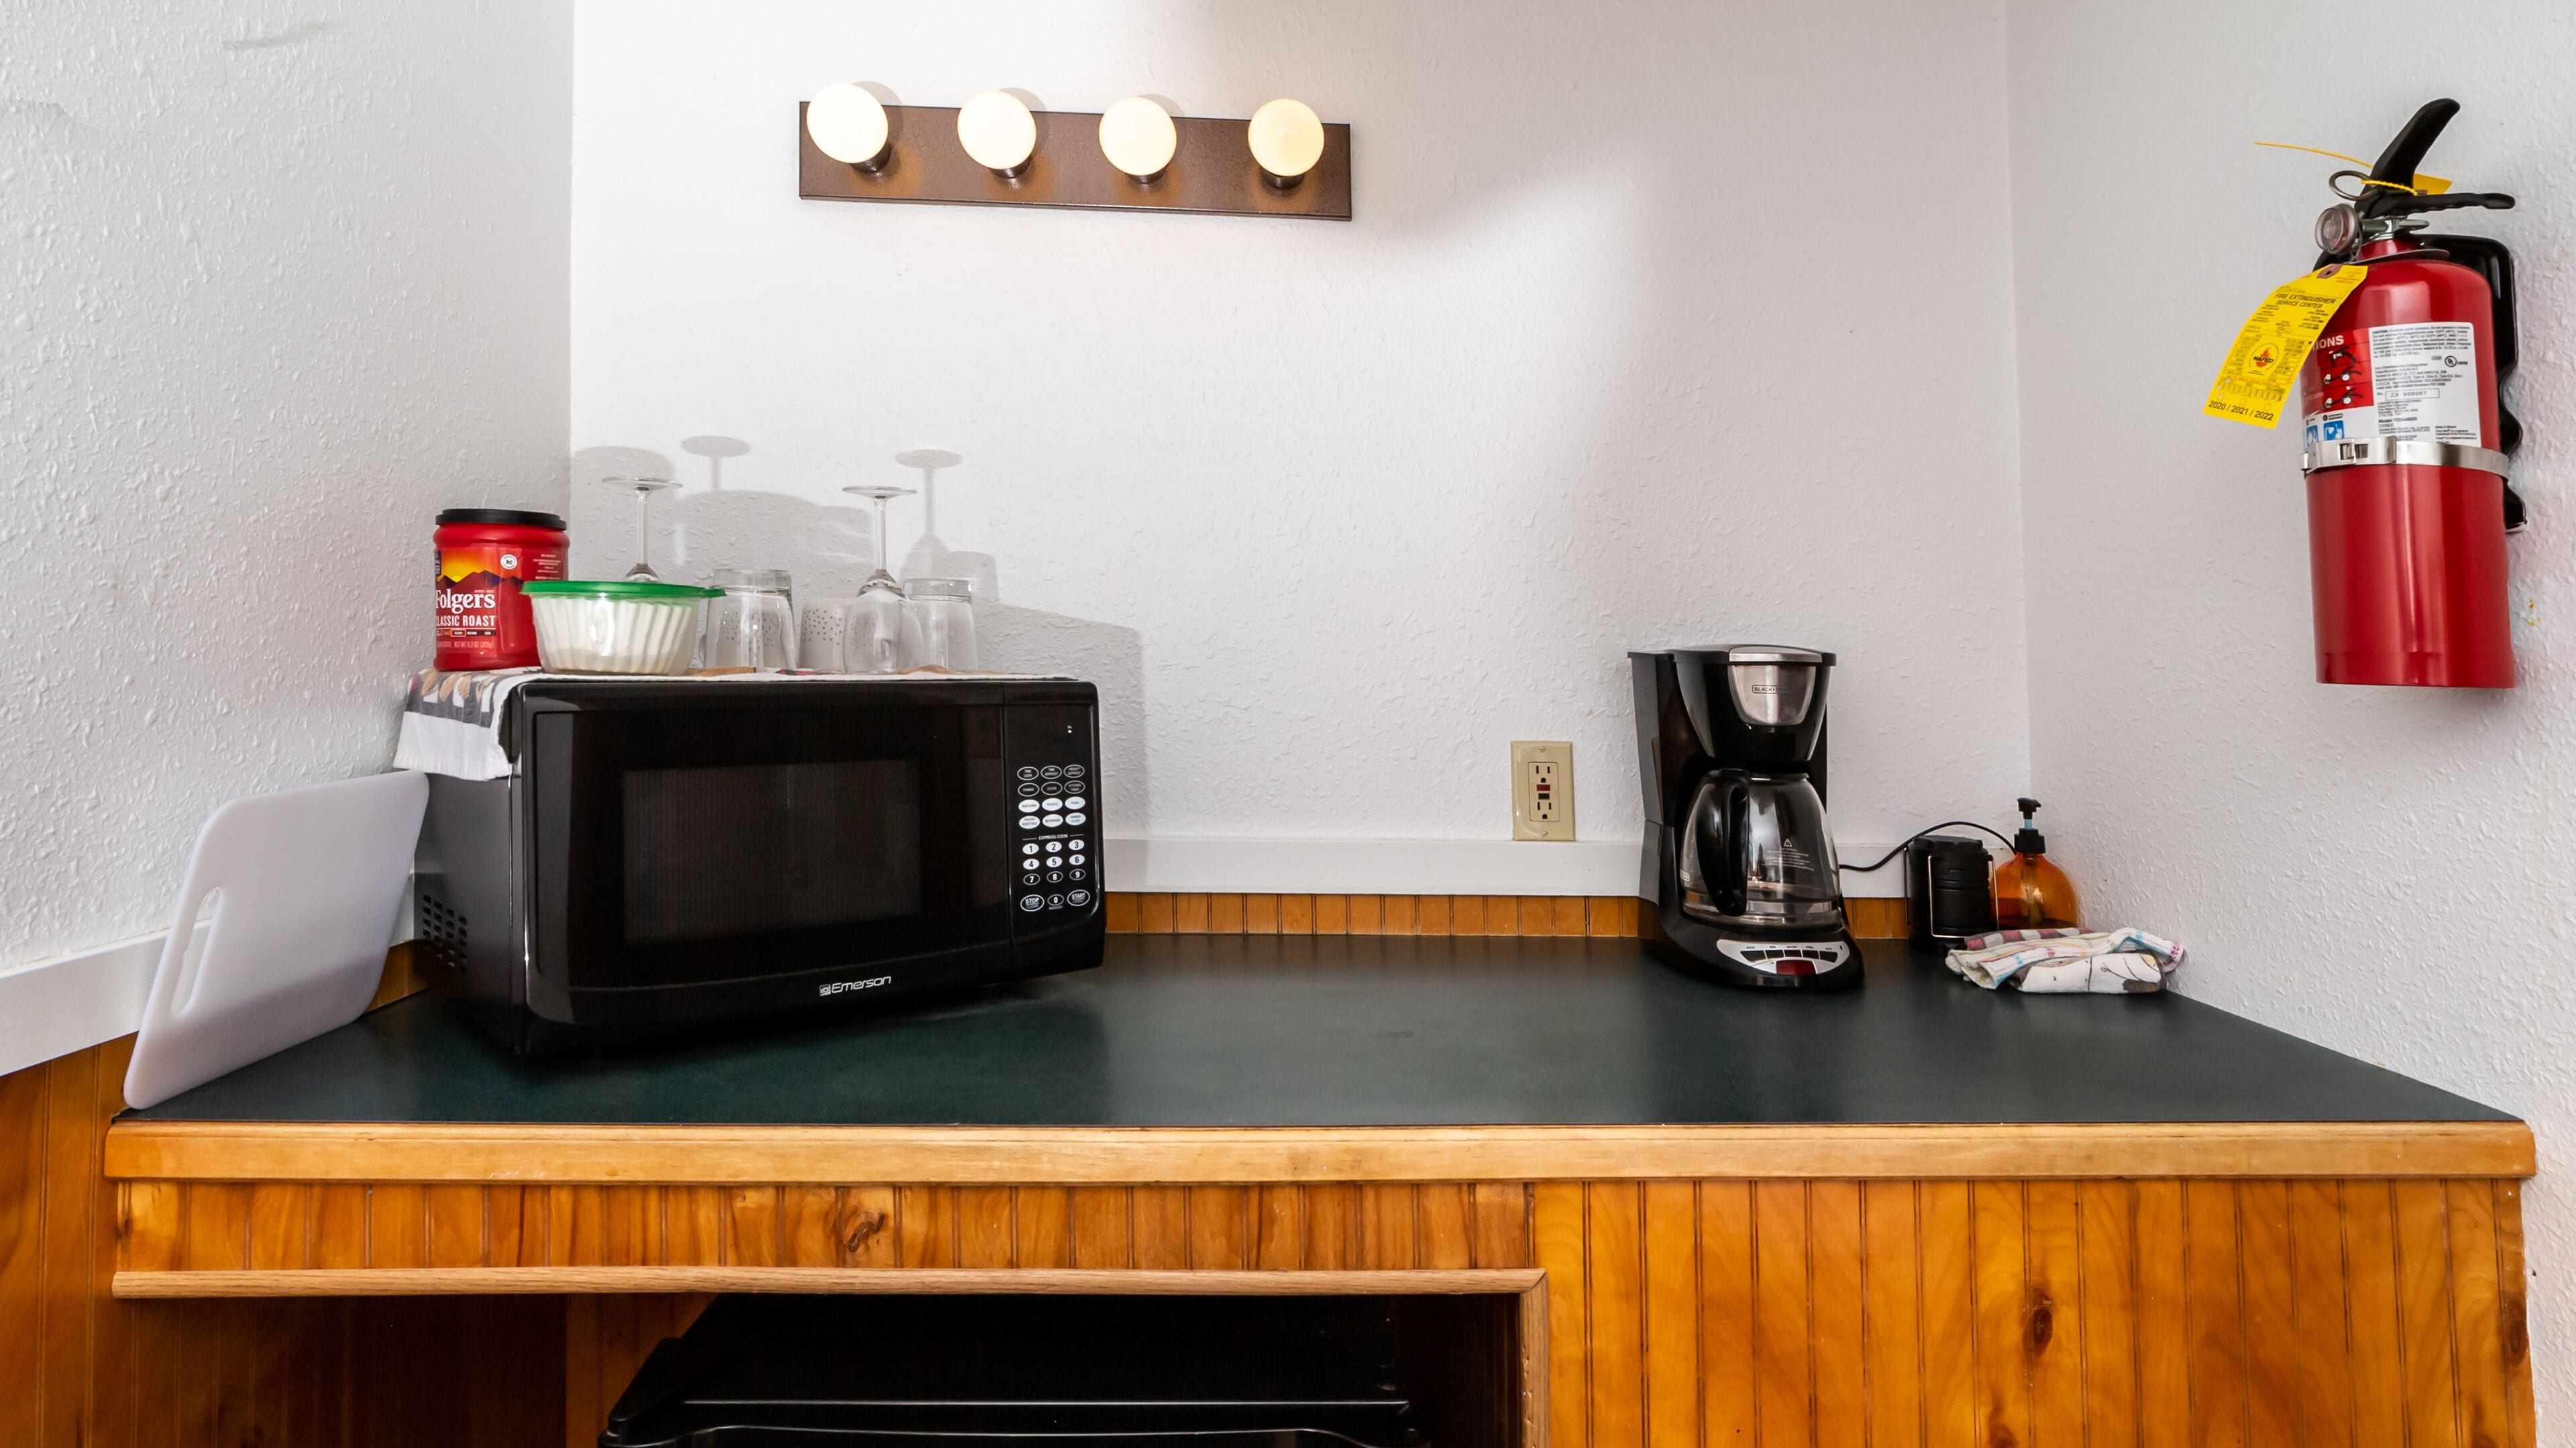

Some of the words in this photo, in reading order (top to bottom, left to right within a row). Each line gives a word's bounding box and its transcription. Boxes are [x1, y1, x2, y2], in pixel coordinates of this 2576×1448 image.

[2288, 294, 2337, 304] EXTINGUISHER
[2253, 355, 2274, 364] NAFED
[2208, 400, 2226, 410] 2020
[2231, 405, 2249, 415] 2021
[2254, 410, 2274, 421] 2022
[436, 588, 496, 614] Folgers
[462, 615, 496, 626] ROAST
[832, 976, 891, 993] Emerson
